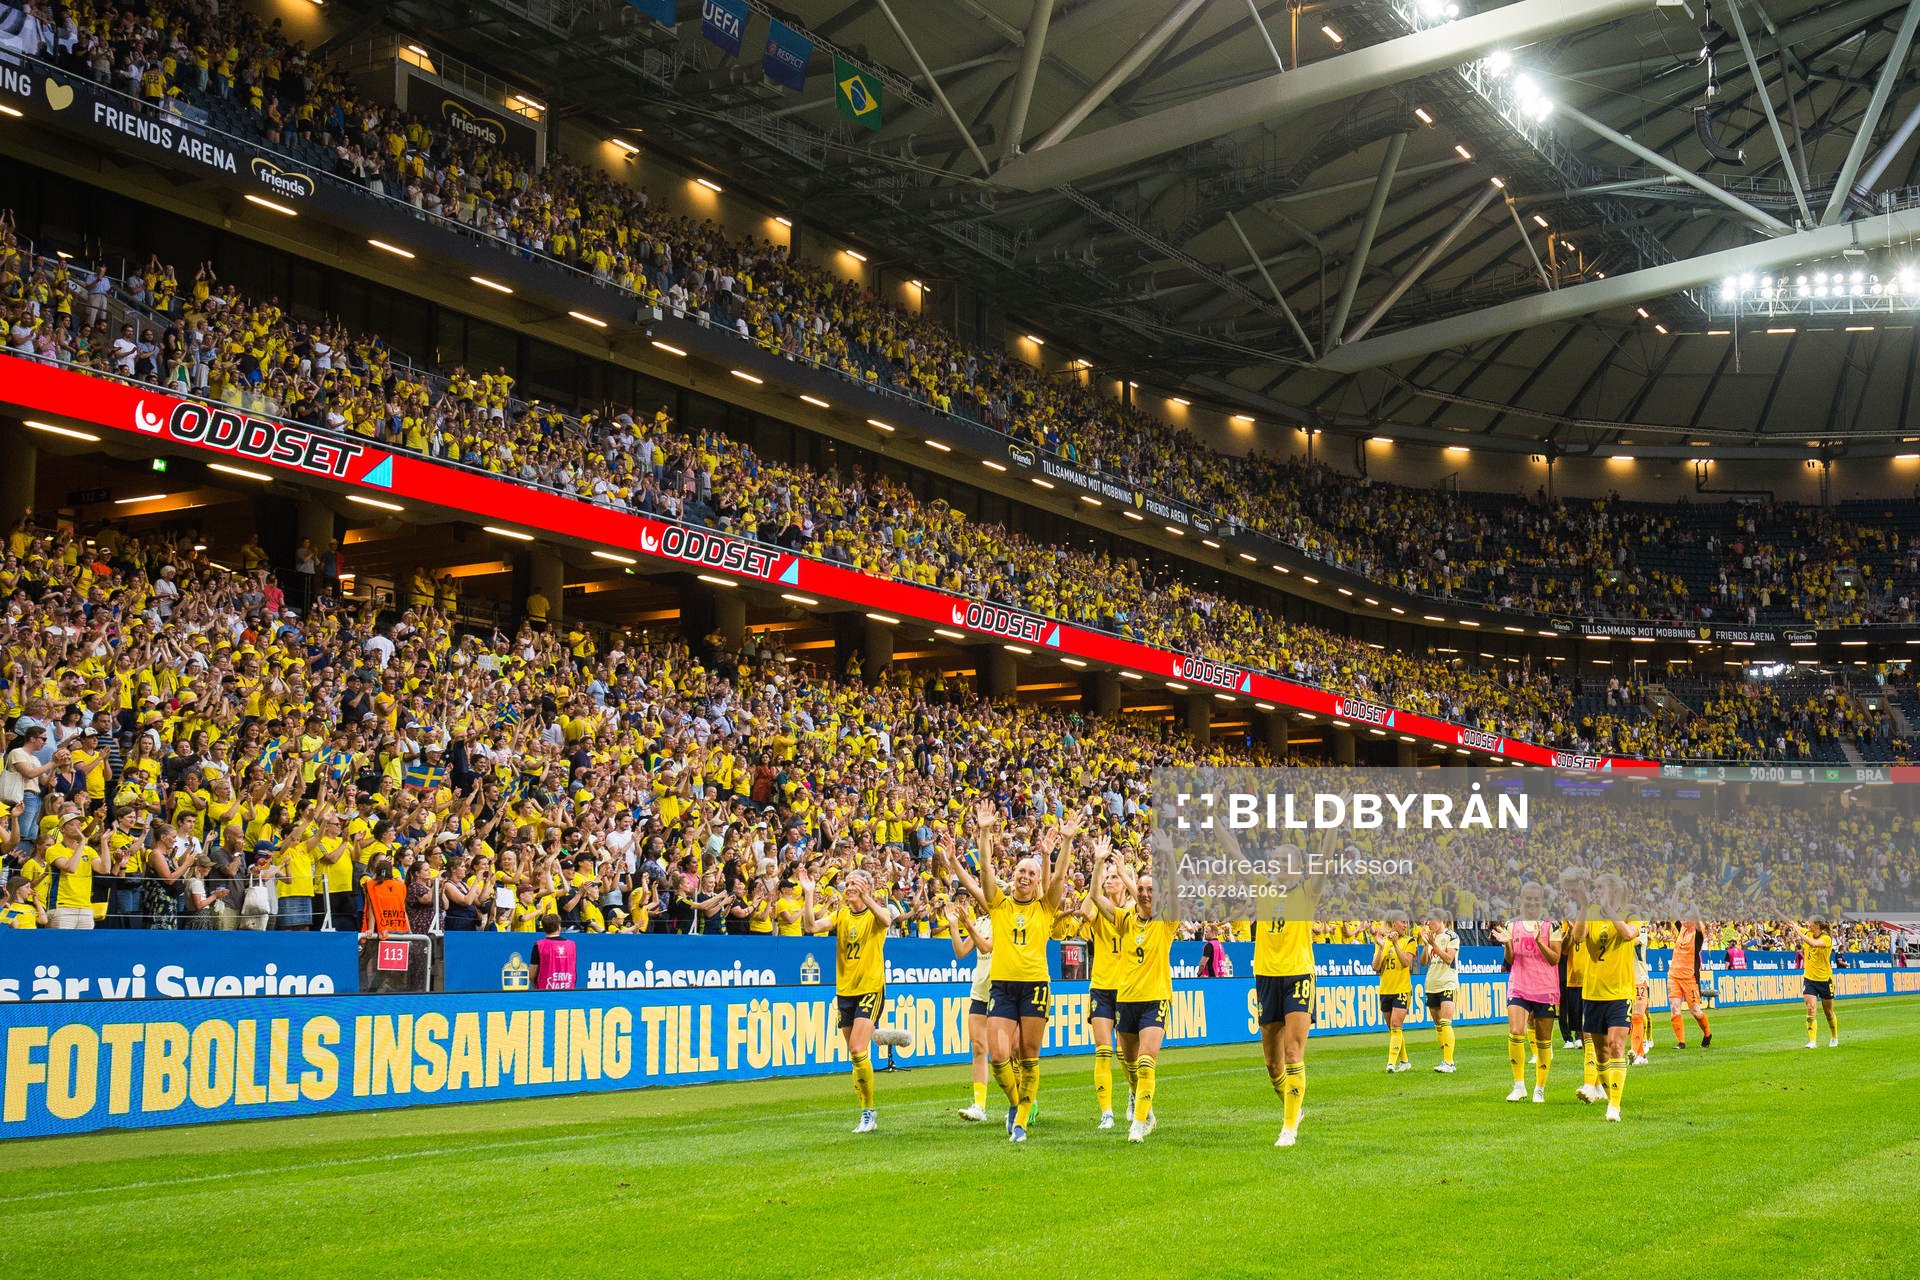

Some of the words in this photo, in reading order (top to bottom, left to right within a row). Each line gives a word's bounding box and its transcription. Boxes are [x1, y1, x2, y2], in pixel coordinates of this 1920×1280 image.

[702, 0, 740, 38] UEFA
[776, 47, 804, 71] RESPECT
[94, 102, 173, 149] FRIENDS
[178, 135, 237, 174] ARENA
[450, 111, 497, 145] friends
[260, 168, 305, 196] friends
[169, 402, 364, 477] ODDSET
[1012, 450, 1032, 466] friends
[1042, 459, 1087, 488] TILLSAMMANS
[1088, 478, 1101, 493] MOT
[1102, 482, 1133, 505] MOBBNING
[1146, 499, 1169, 520] FRIENDS
[1170, 507, 1189, 526] ARENA
[661, 525, 780, 578] ODDSET
[965, 603, 1047, 643] ODDSET
[1580, 624, 1636, 636] TILLSAMMANS
[1638, 627, 1654, 638] MOT
[1656, 628, 1696, 639] MOBBNING
[1715, 630, 1747, 641] FRIENDS
[1750, 631, 1775, 642] ARENA
[1787, 632, 1812, 641] friends
[1182, 657, 1241, 690] ODDSET
[1342, 698, 1387, 726] ODDSET
[1463, 728, 1499, 753] ODDSET
[1556, 752, 1601, 770] ODDSET
[1664, 764, 1683, 777] SWE
[1718, 767, 1726, 780] 3
[1750, 767, 1785, 781] 90:00
[1809, 768, 1815, 781] 1
[1856, 769, 1884, 781] BRA
[1012, 928, 1027, 945] 11
[384, 948, 403, 961] 113
[847, 943, 860, 960] 22
[1067, 950, 1078, 961] 112
[1136, 947, 1145, 964] 9
[1598, 946, 1606, 962] 2
[1386, 958, 1396, 970] 15
[32, 964, 90, 999] är
[98, 963, 146, 998] vi
[1292, 979, 1310, 999] 18
[858, 993, 876, 1008] 22
[1031, 986, 1048, 1005] 11
[3, 1015, 341, 1123] FOTBOLLS
[353, 1006, 632, 1097] INSAMLING
[641, 1004, 719, 1077] TILL
[726, 997, 871, 1071] FÖRMÅ
[878, 994, 936, 1059] FÖR
